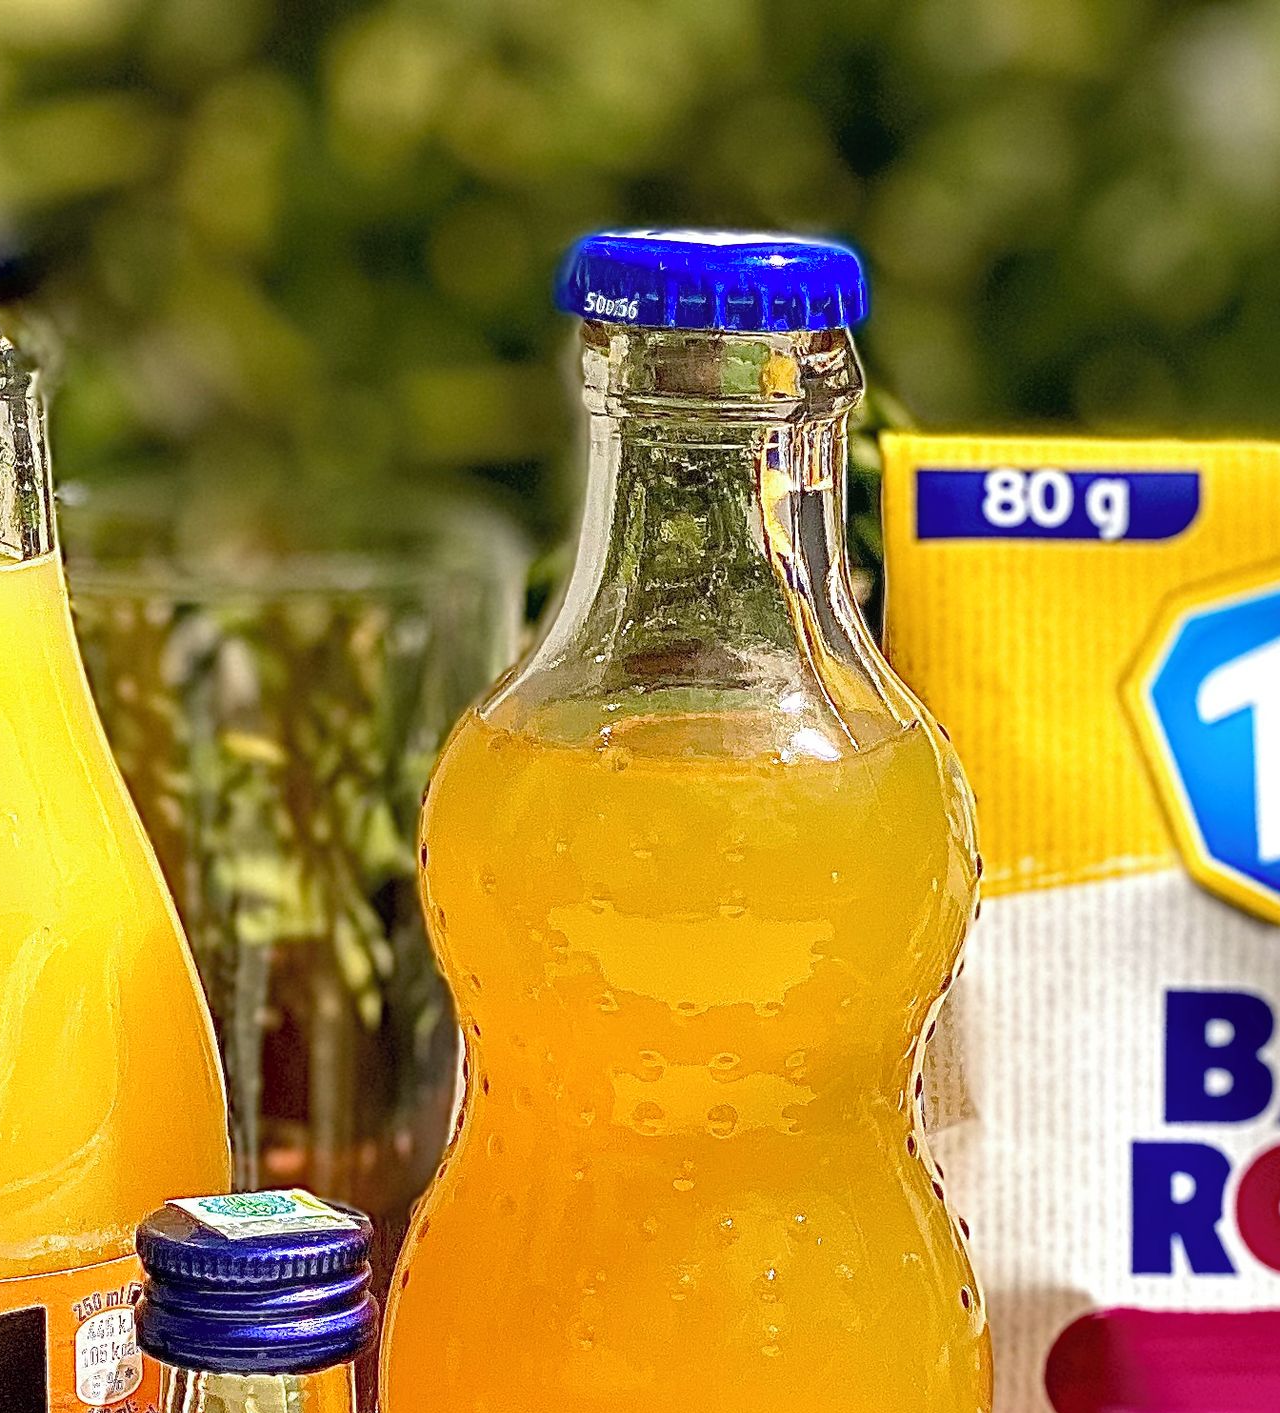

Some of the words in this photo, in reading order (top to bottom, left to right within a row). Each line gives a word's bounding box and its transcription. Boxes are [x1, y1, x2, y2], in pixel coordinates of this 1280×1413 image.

[982, 470, 1073, 530] 80
[1086, 477, 1130, 541] g
[73, 1292, 102, 1322] 250
